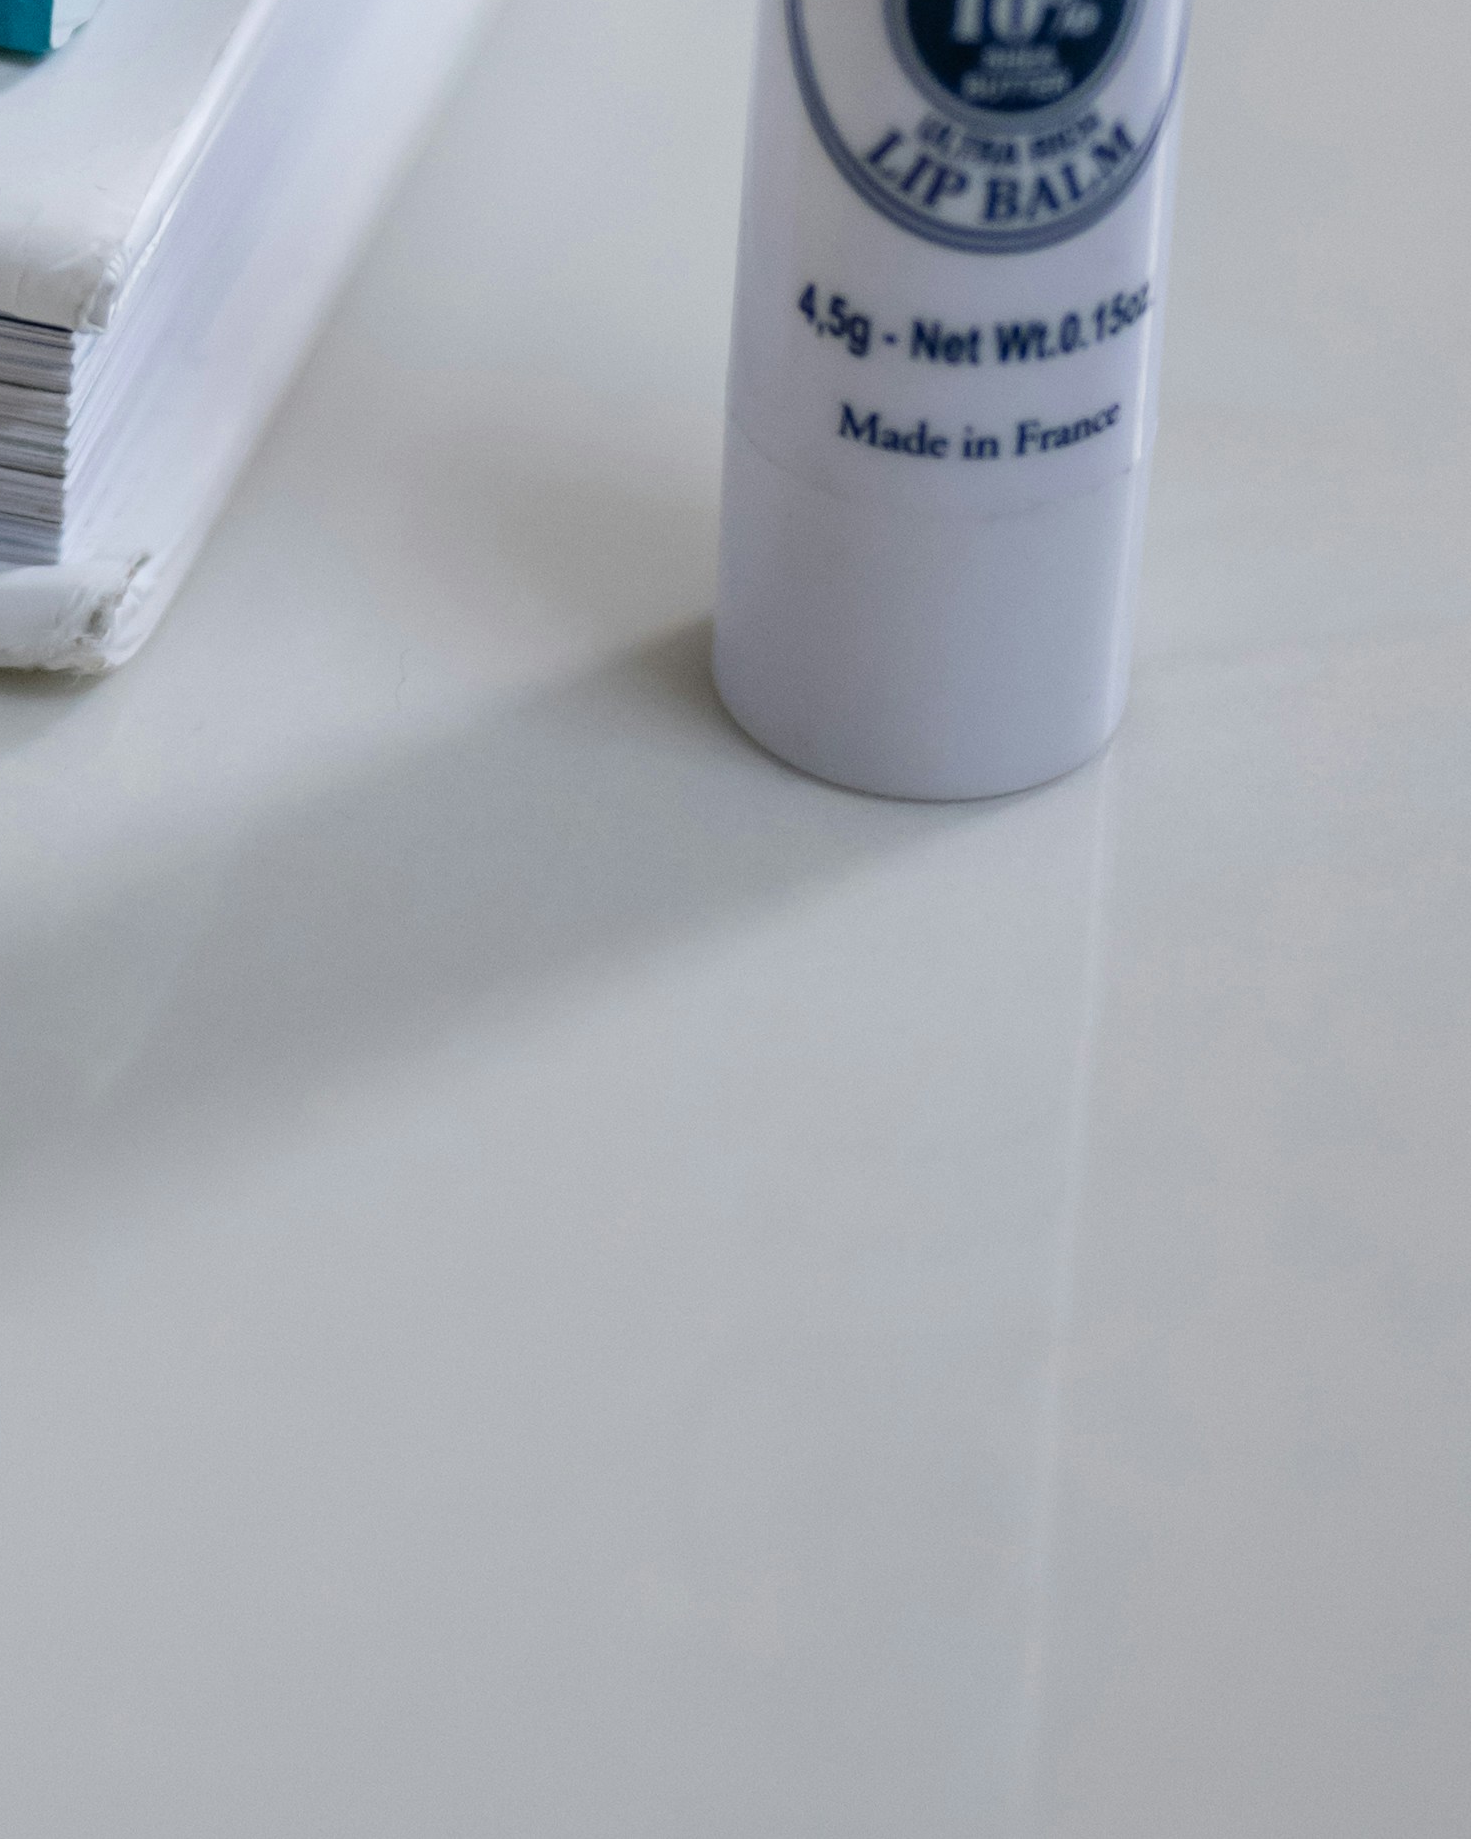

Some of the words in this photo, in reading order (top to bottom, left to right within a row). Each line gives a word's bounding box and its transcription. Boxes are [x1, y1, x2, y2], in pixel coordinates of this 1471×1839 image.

[868, 127, 969, 208] LIP
[983, 119, 1137, 223] BALM
[910, 318, 982, 365] Net
[839, 399, 950, 459] Made
[962, 425, 1000, 460] in
[1014, 403, 1121, 457] France
